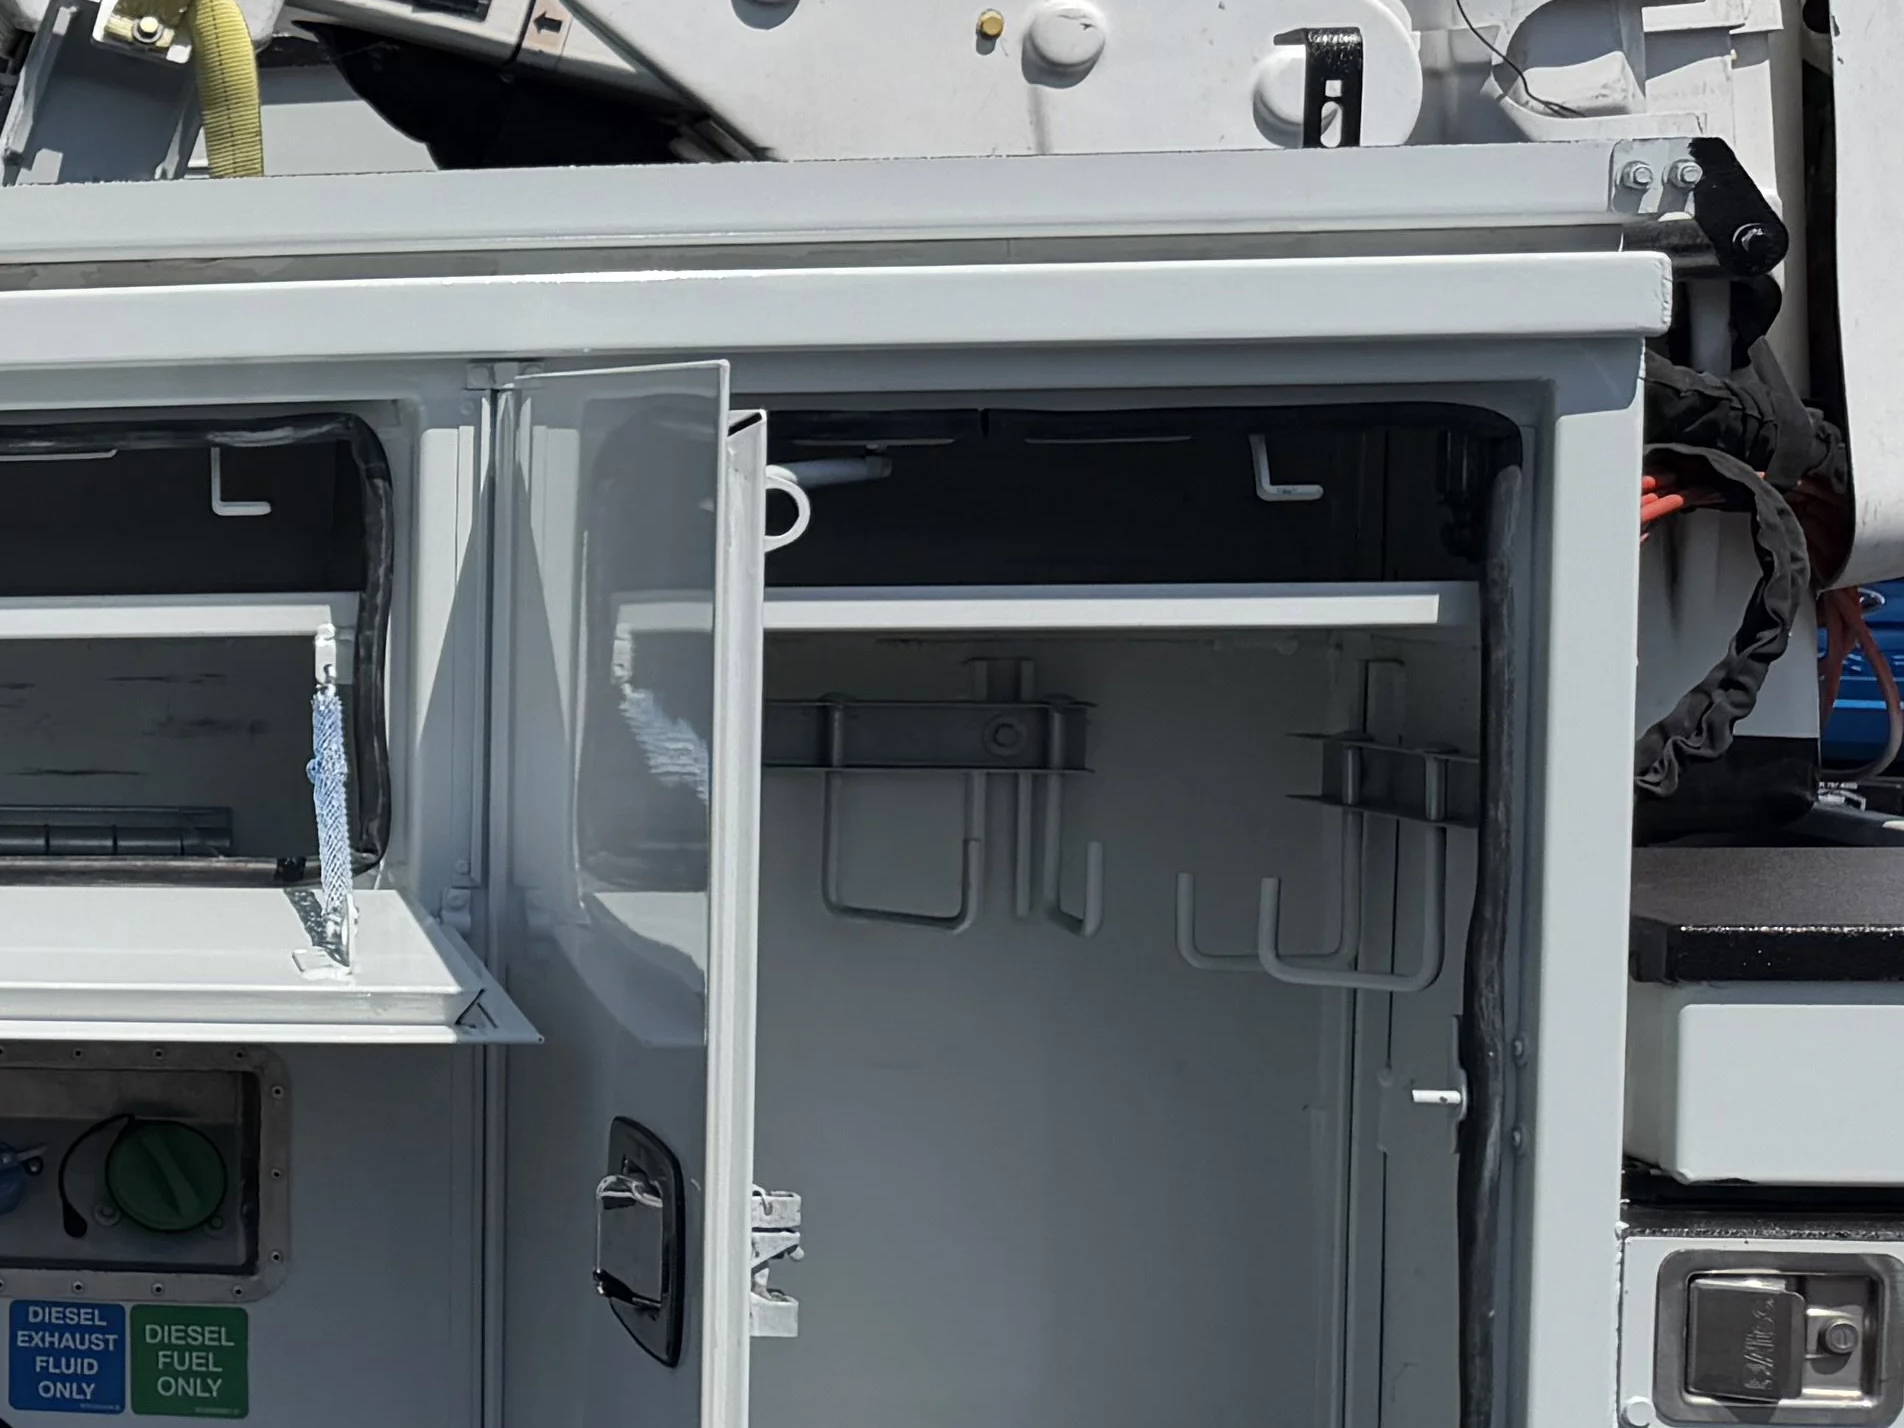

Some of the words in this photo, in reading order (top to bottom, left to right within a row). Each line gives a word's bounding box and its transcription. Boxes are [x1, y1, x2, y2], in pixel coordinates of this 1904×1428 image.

[28, 1306, 108, 1326] DIESEL
[16, 1331, 119, 1352] EXHAUST
[144, 1324, 235, 1347] DIESEL
[35, 1356, 99, 1376] FLUID
[157, 1351, 223, 1372] FUEL
[37, 1380, 96, 1400] ONLY
[156, 1376, 223, 1398] ONLY
